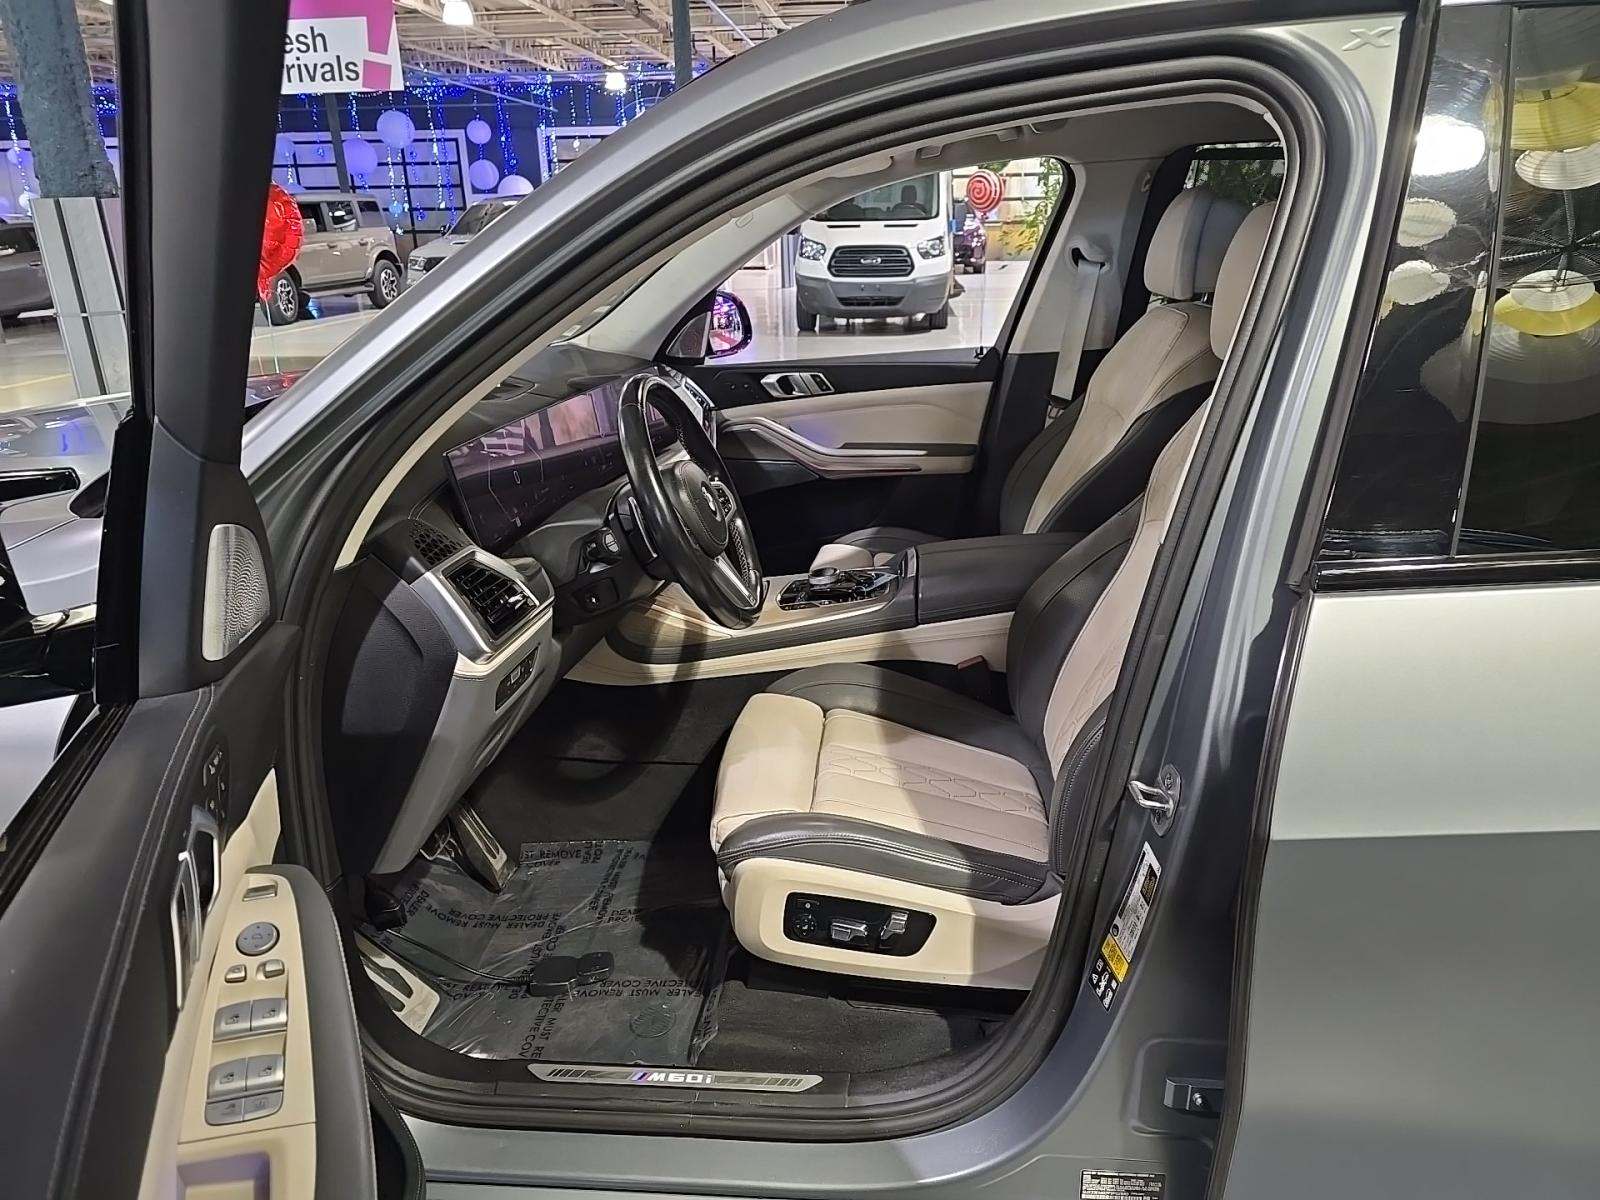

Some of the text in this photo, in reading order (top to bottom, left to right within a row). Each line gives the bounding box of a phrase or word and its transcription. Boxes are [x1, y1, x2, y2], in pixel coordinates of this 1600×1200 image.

[283, 26, 328, 53] esh
[285, 55, 360, 83] rivals
[574, 987, 702, 998] EALER MUST REMOVE
[601, 979, 689, 988] TECTIVE COVER
[540, 1017, 557, 1040] MUST
[518, 1034, 536, 1058] COV
[531, 1046, 545, 1058] RE
[647, 1071, 713, 1084] M60i
